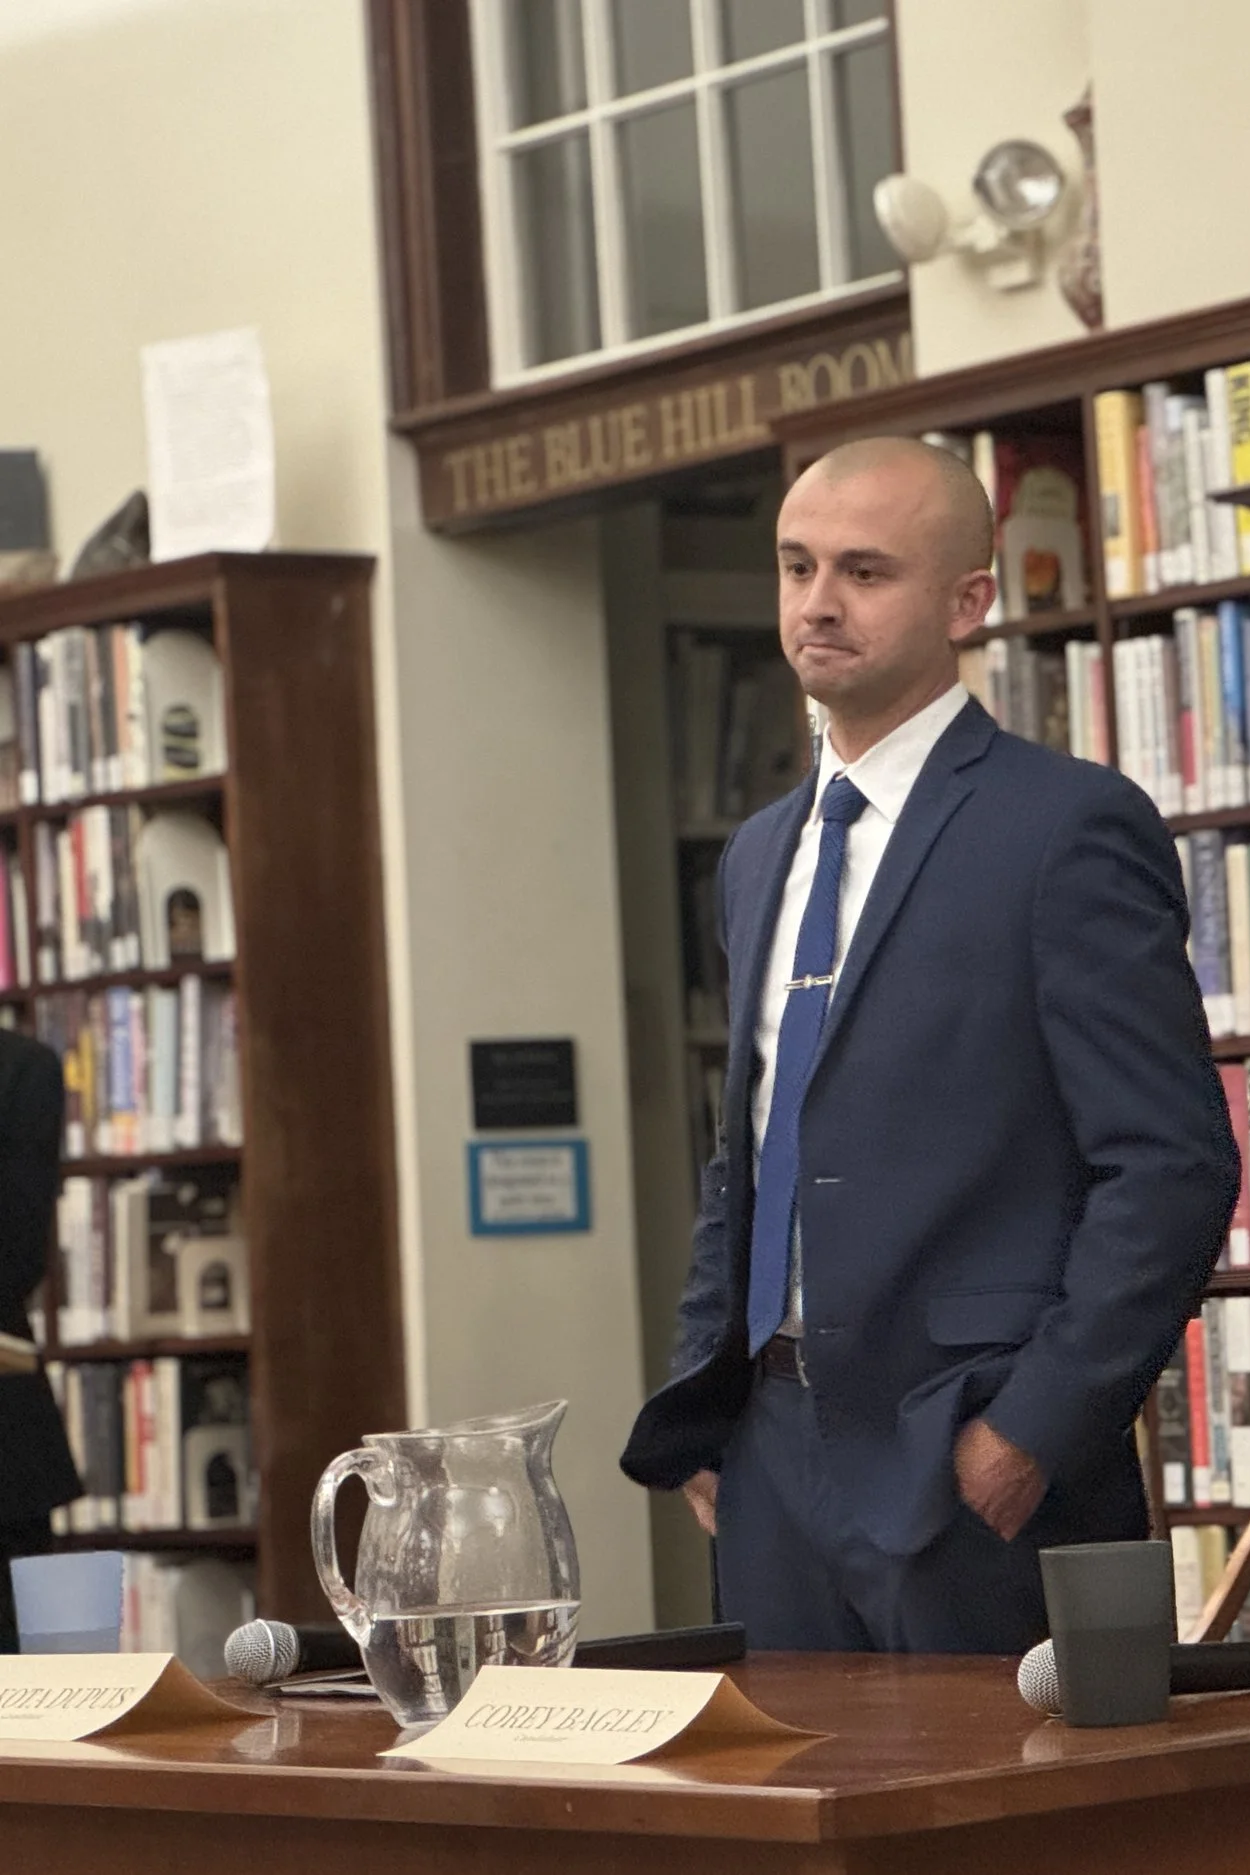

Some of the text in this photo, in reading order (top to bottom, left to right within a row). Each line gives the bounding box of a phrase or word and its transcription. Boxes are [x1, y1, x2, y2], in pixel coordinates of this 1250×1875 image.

[443, 434, 538, 512] THE
[543, 404, 652, 487] BLUE
[659, 374, 771, 458] HILL
[464, 1703, 674, 1734] COREY BAGLEY
